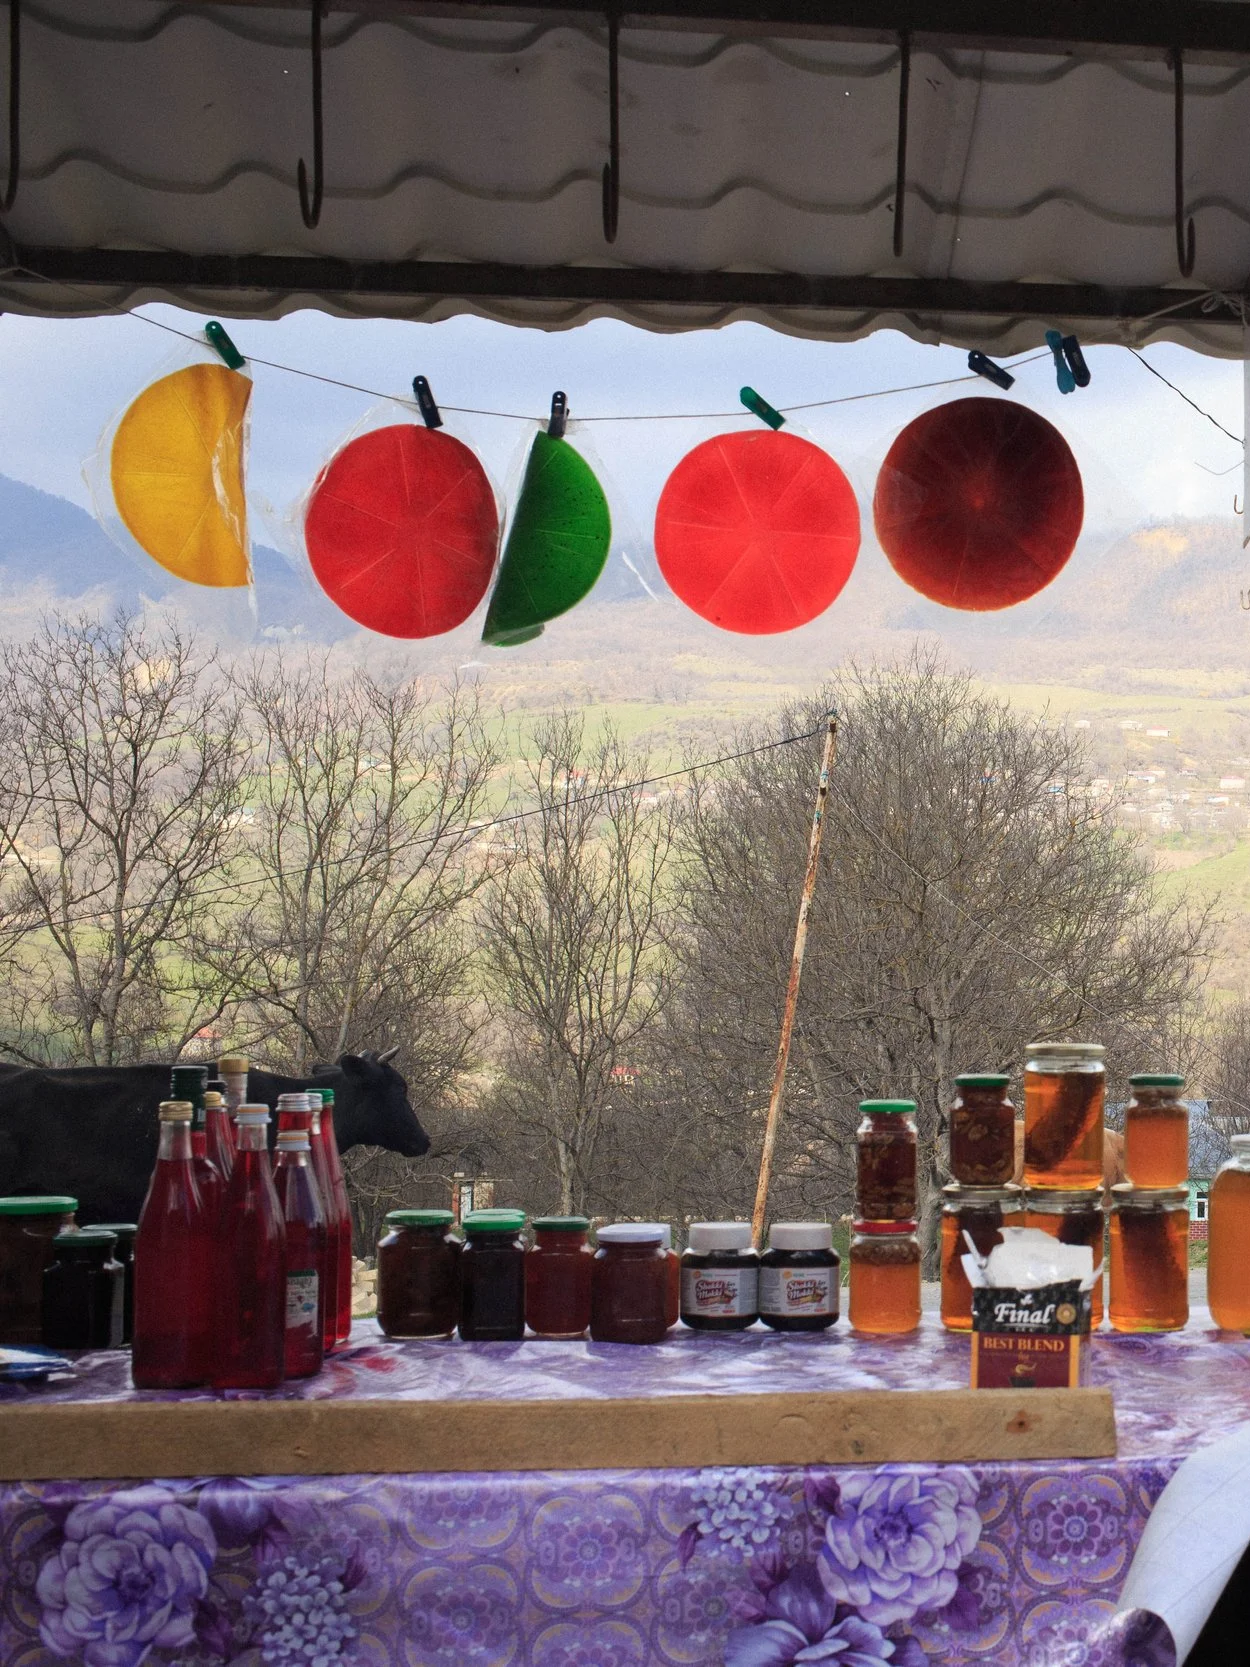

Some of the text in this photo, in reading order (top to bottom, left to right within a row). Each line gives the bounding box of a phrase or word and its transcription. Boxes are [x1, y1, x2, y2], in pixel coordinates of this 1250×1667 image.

[994, 1303, 1056, 1324] Final
[984, 1337, 1065, 1352] BEST BLEND
